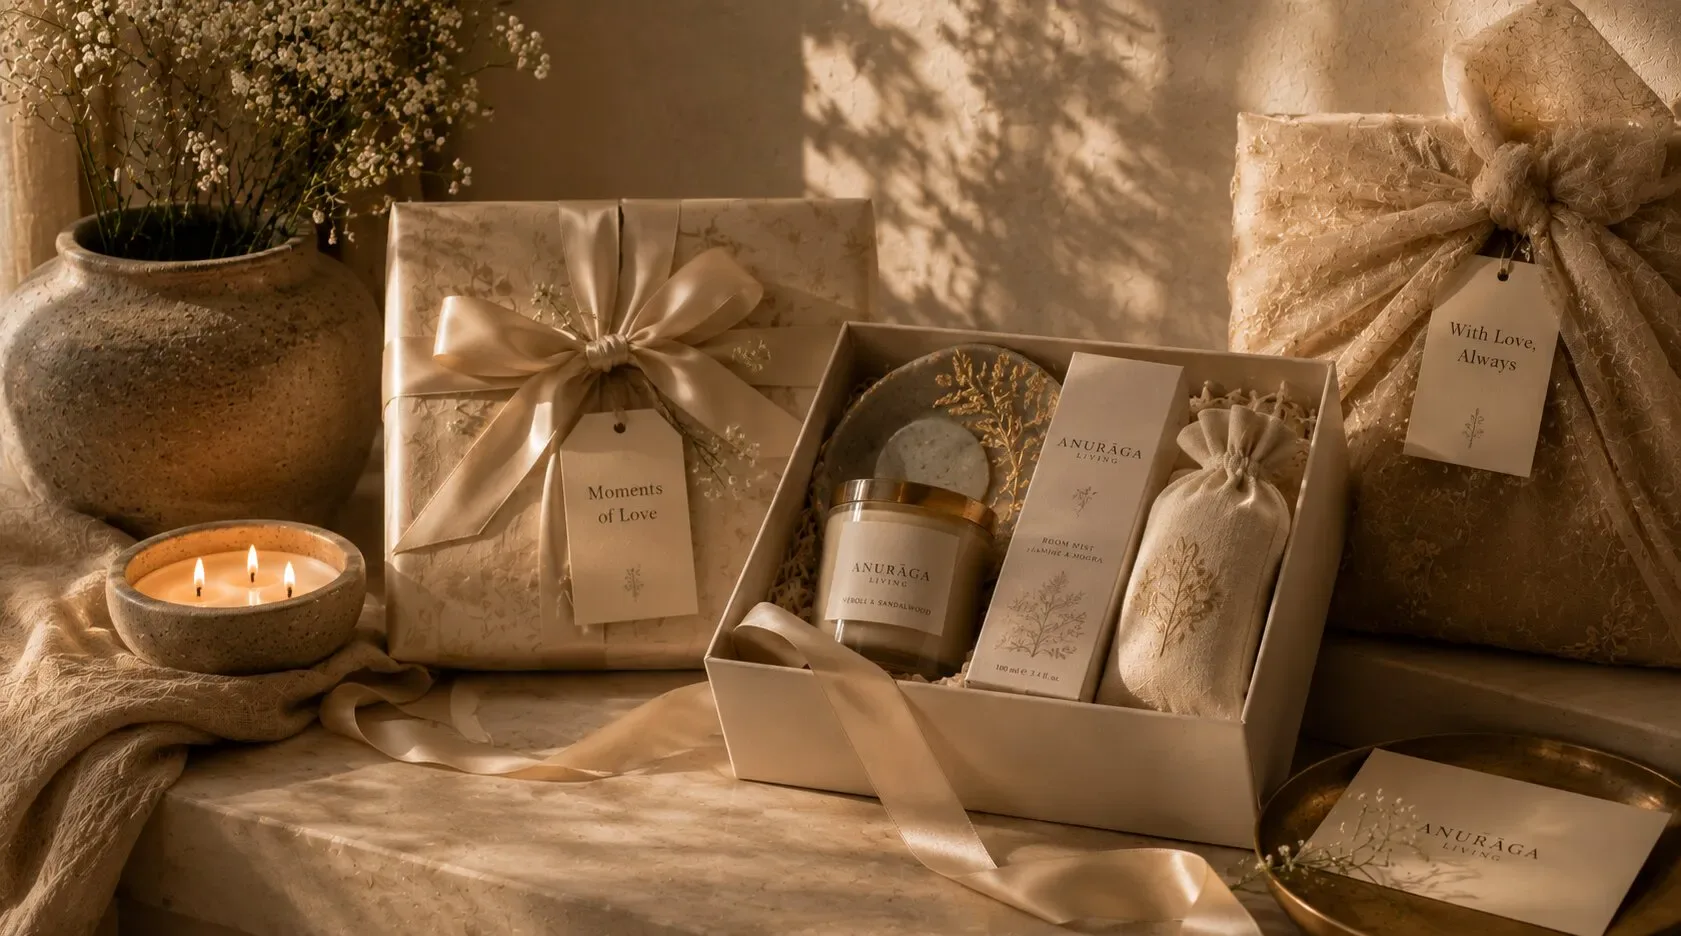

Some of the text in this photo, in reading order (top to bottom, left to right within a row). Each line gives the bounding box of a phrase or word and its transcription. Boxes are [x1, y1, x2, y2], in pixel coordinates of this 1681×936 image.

[1450, 321, 1536, 352] With Love,
[1457, 349, 1517, 374] Always
[1057, 437, 1142, 459] ANURĀGA
[1076, 453, 1118, 464] LIVING
[588, 484, 663, 500] Moments
[598, 507, 658, 524] of Love
[1041, 537, 1069, 547] ROOM
[852, 562, 930, 582] ANURĀGA
[868, 577, 908, 588] LIVING
[877, 600, 932, 616] SANDALWOOD
[995, 664, 1009, 673] 100
[1442, 842, 1501, 862] LIVING
